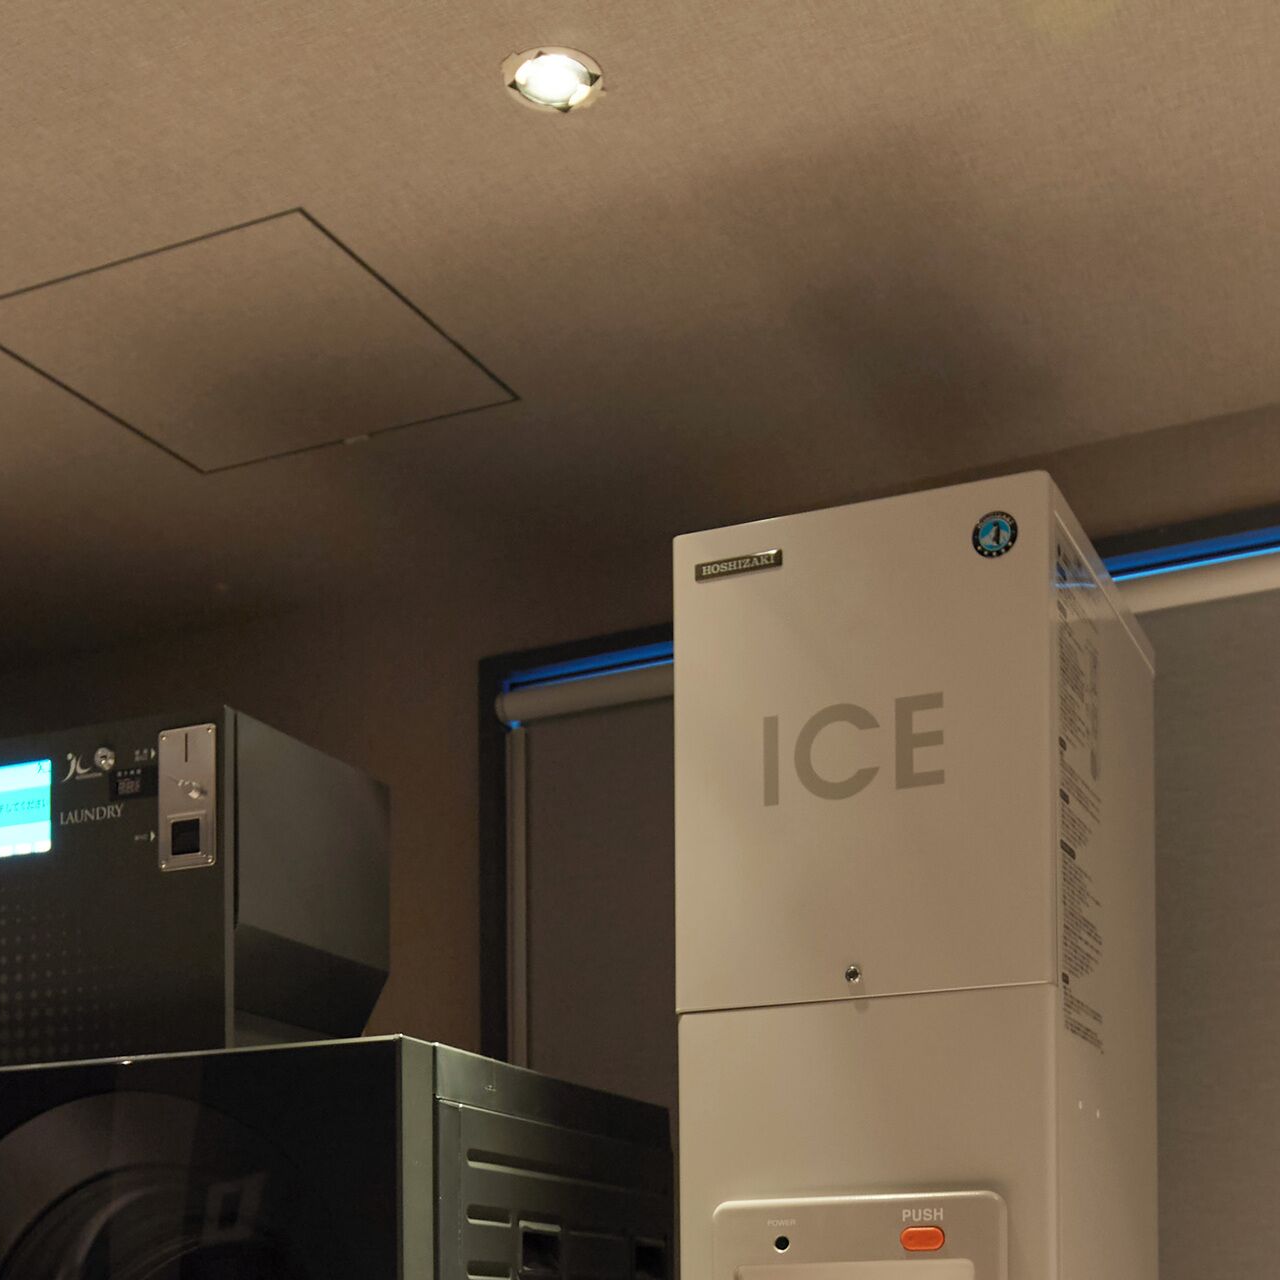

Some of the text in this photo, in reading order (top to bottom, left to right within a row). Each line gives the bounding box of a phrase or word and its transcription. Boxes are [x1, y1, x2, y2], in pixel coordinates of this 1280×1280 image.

[701, 554, 776, 575] HOSHIZAKI
[762, 691, 946, 807] ICE
[59, 803, 124, 825] LAUNDRY
[767, 1218, 797, 1228] POWER
[902, 1207, 944, 1222] PUSH
